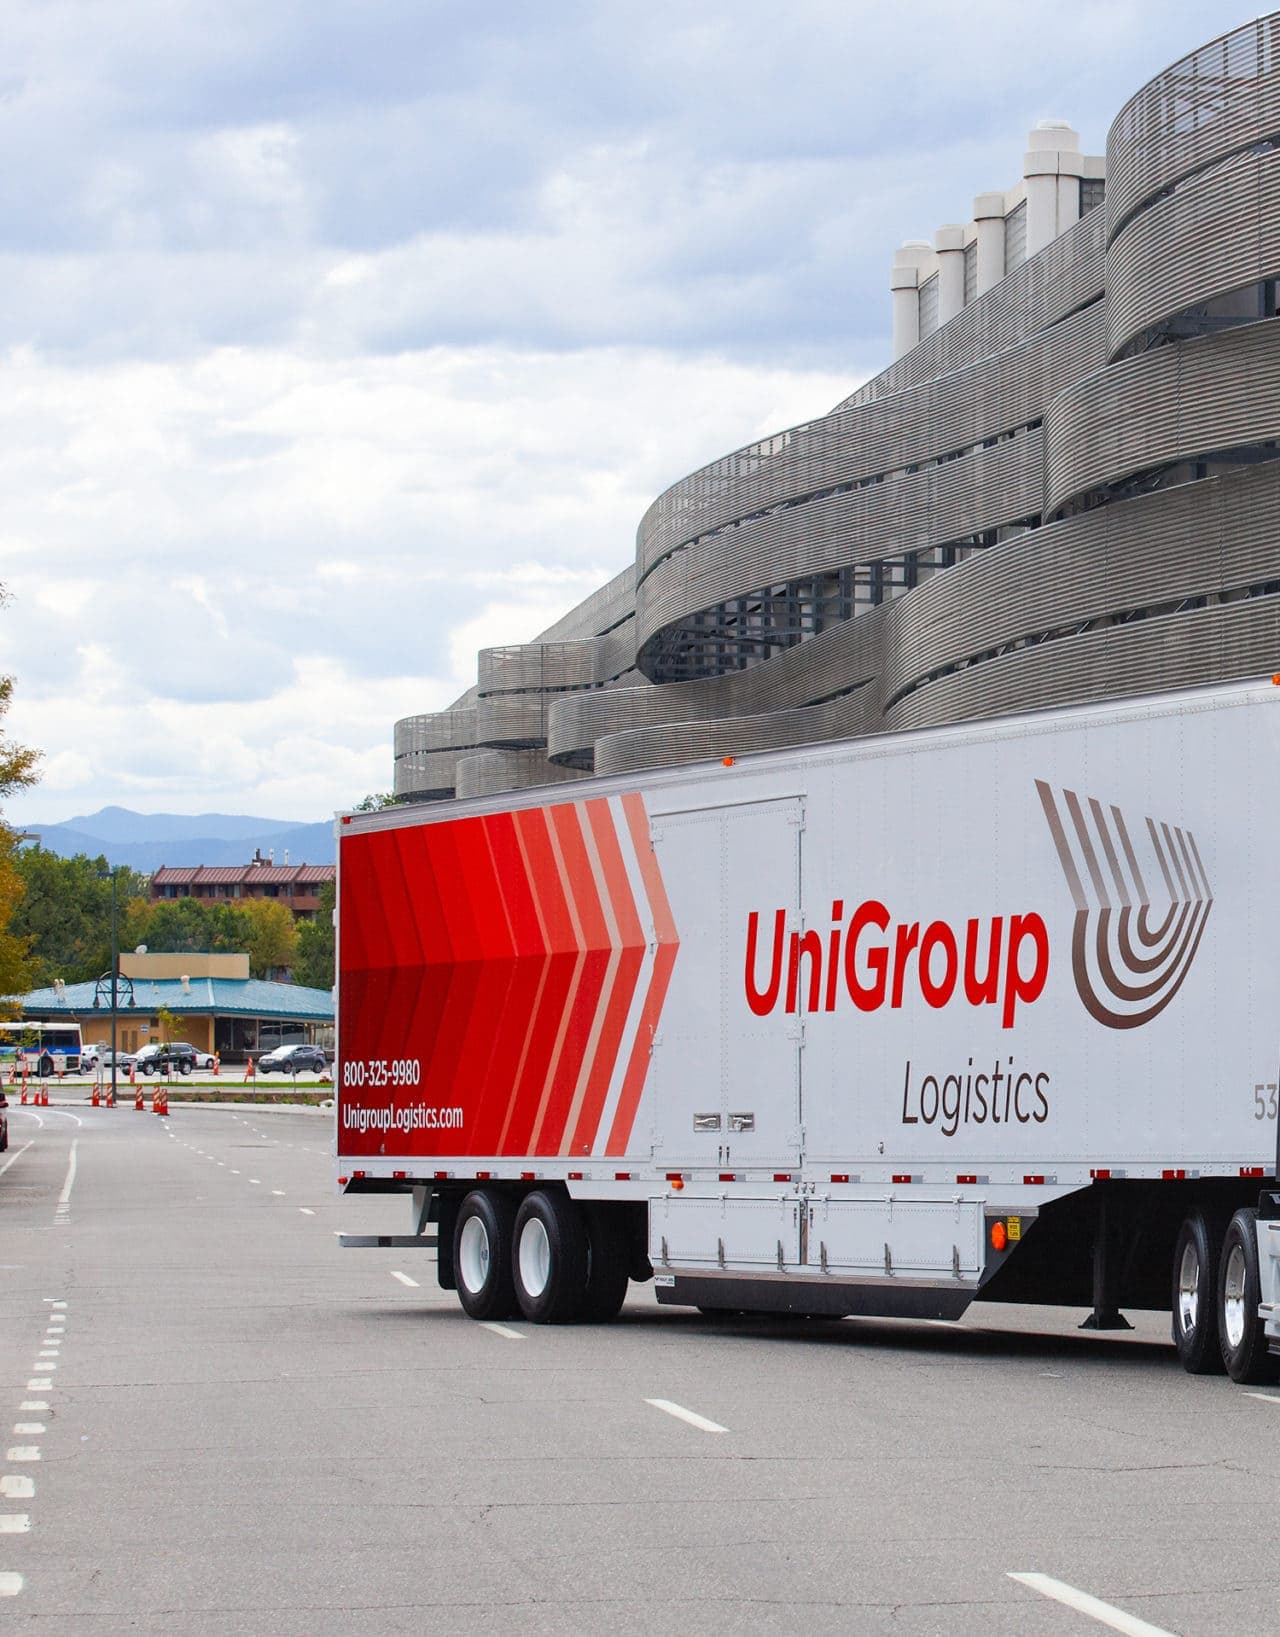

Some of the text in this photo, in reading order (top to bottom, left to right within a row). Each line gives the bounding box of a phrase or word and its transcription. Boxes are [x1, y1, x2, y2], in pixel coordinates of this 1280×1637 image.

[745, 900, 1049, 1029] UniGroup
[343, 1059, 420, 1087] 800-325-9980
[902, 1056, 1050, 1136] Logistics
[1254, 1084, 1278, 1120] 53
[343, 1102, 463, 1133] UnigroupLogistics.com
